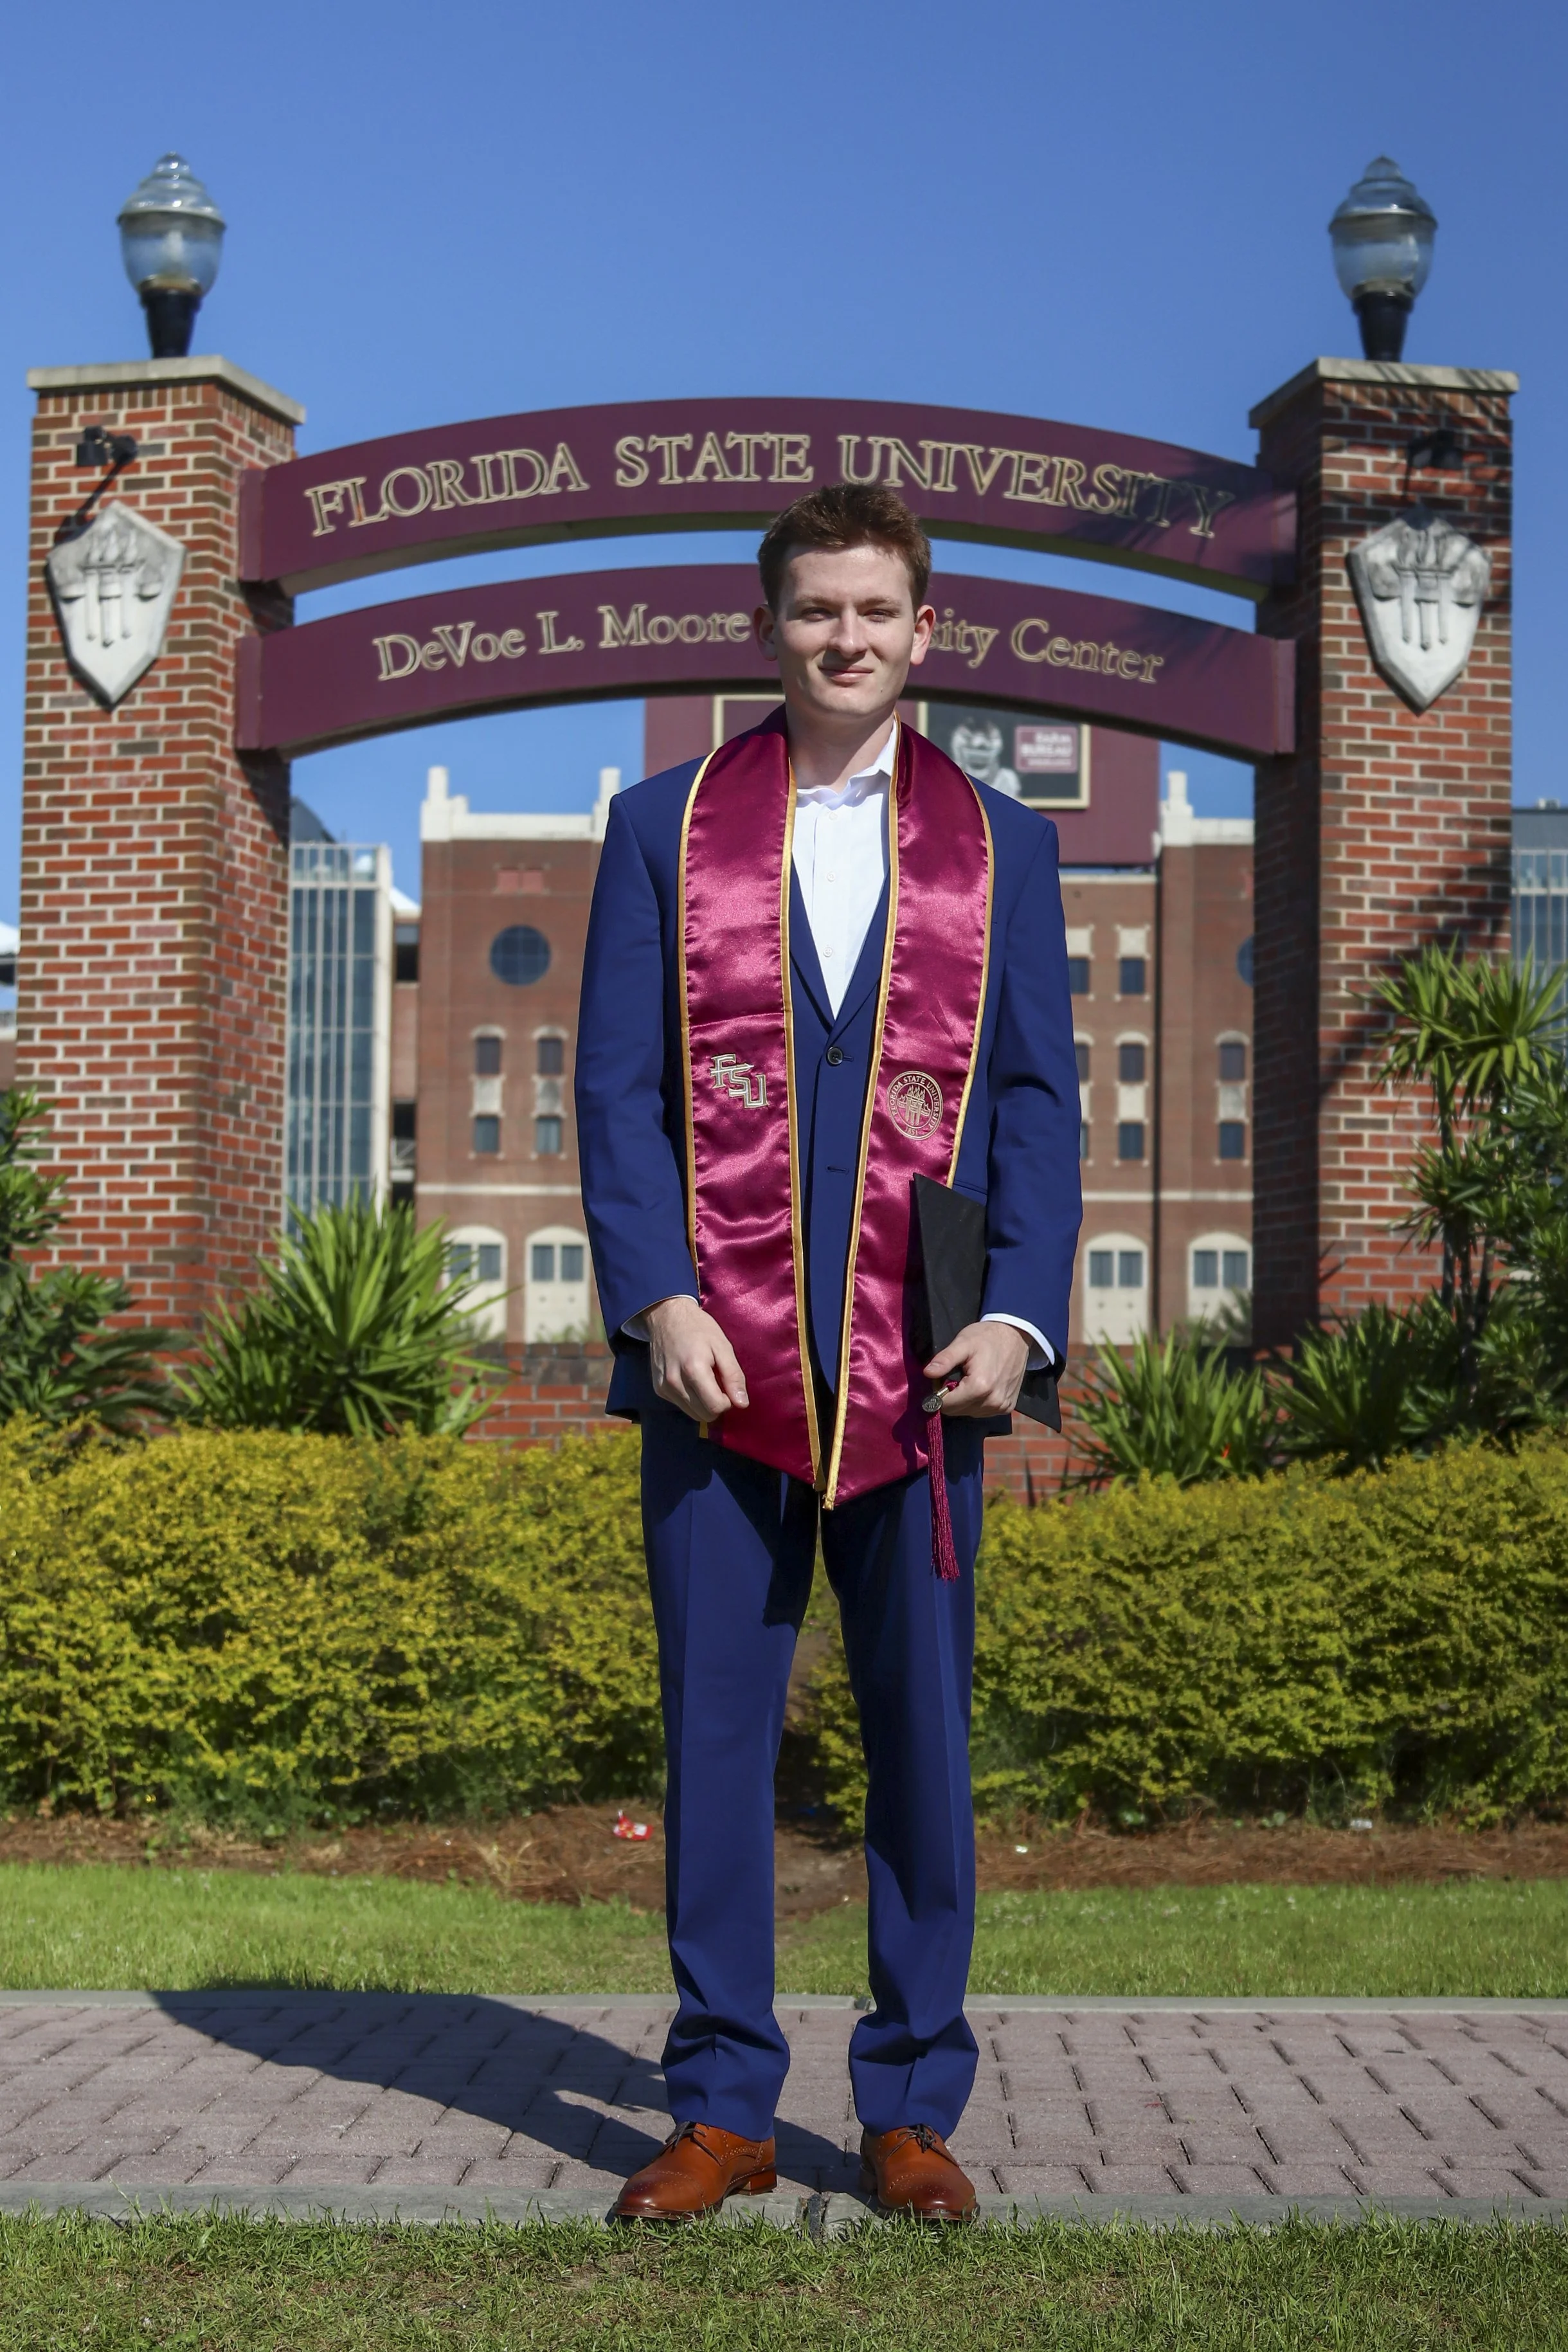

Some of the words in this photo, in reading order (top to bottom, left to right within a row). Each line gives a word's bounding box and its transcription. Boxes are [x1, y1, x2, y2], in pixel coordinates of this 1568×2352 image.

[305, 443, 588, 536] FLORIDA
[616, 433, 813, 487] STATE
[838, 435, 1234, 538] UNIVERSITY
[374, 622, 525, 680] DeVoe
[537, 612, 583, 653] L.
[599, 604, 751, 648] Moore
[1013, 619, 1164, 683] Center
[709, 1054, 770, 1108] FSU
[890, 1081, 903, 1116] FLORIDA
[904, 1076, 926, 1084] STATE
[926, 1082, 939, 1130] UNIVERSITY
